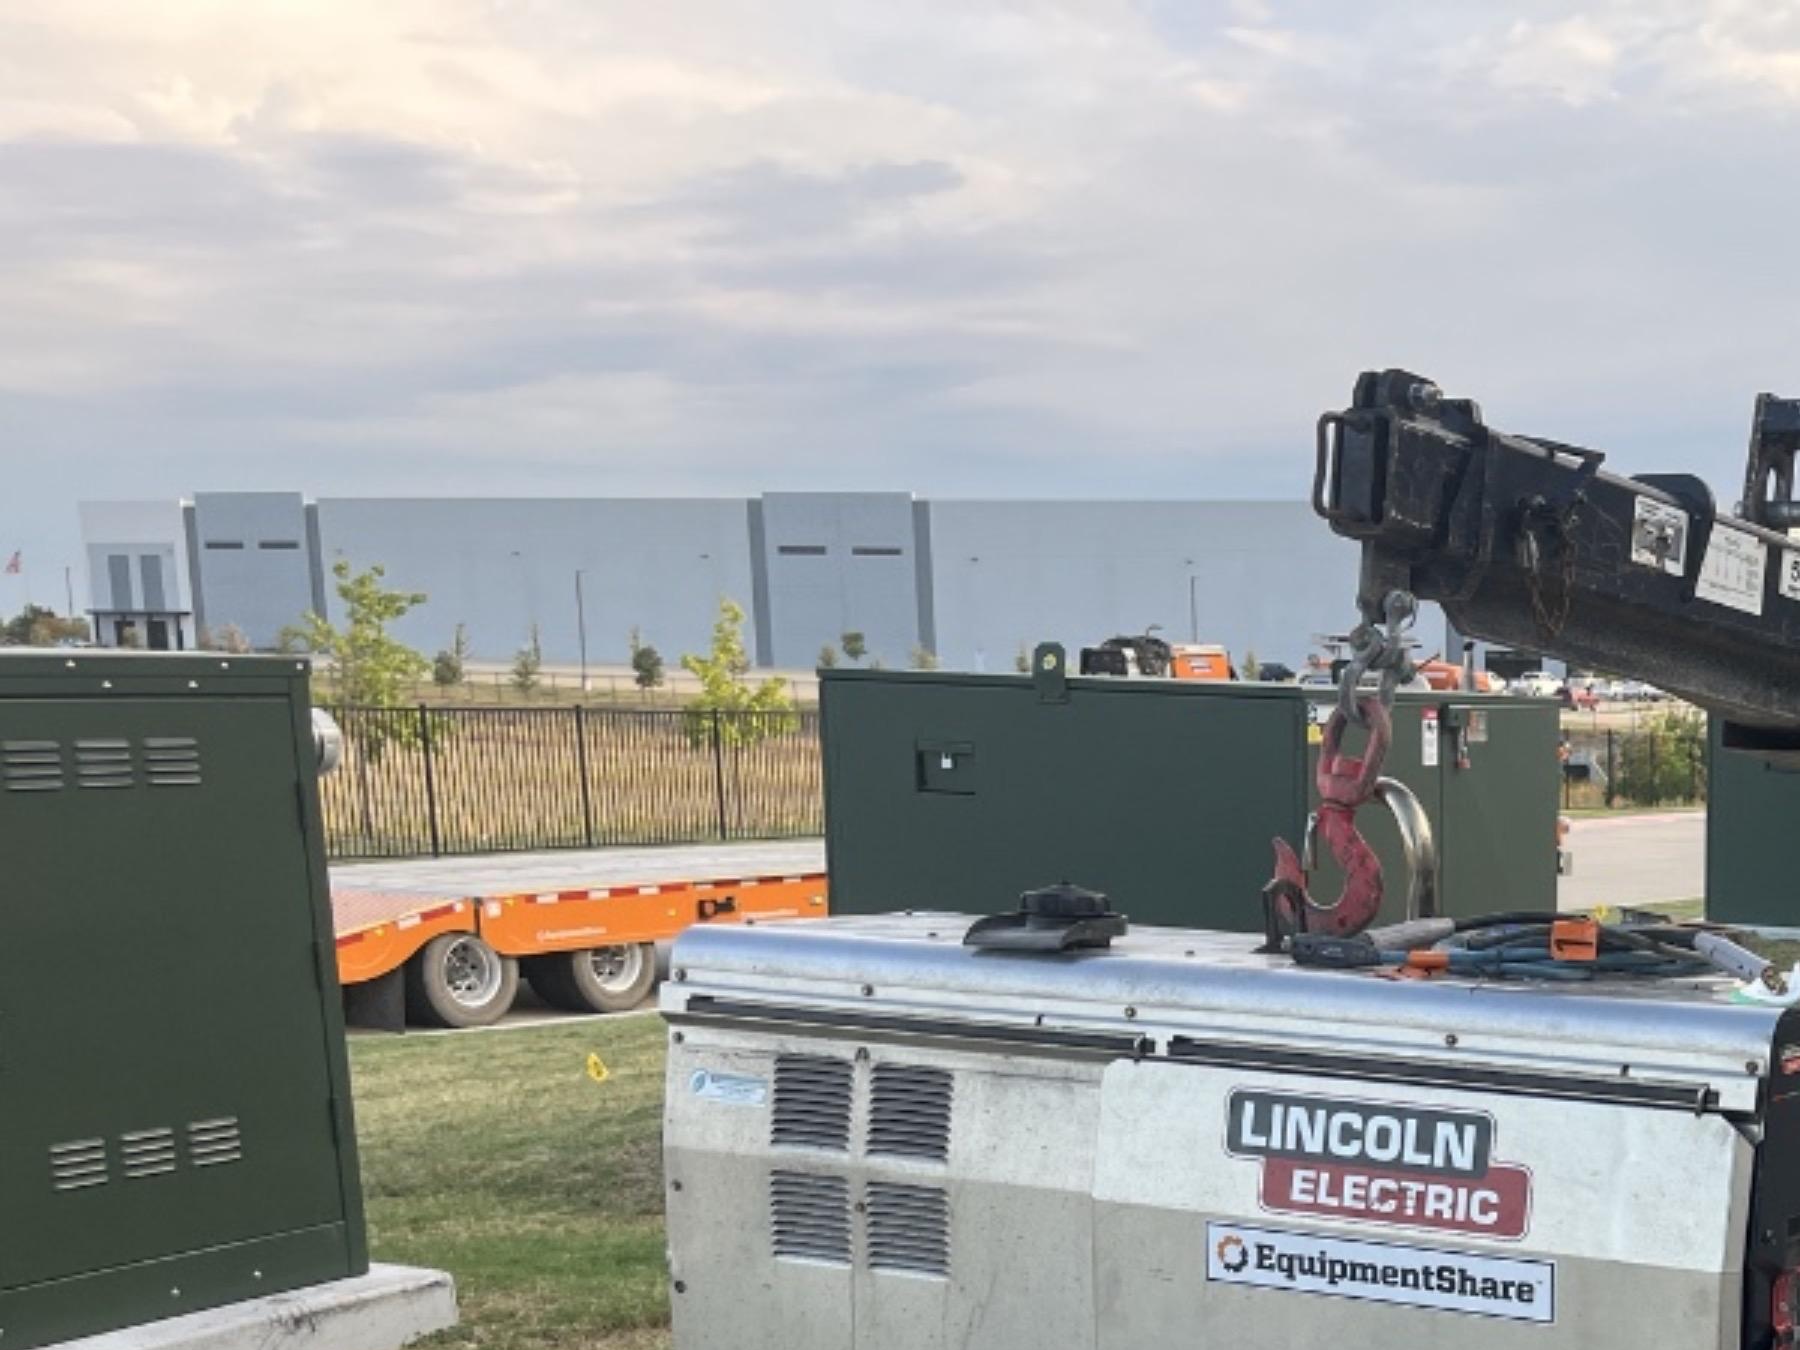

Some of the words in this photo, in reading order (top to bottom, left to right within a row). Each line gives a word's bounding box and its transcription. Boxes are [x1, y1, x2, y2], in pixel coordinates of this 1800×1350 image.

[1240, 1100, 1477, 1171] LINCOLN
[1289, 1169, 1499, 1225] ELECTRIC
[1255, 1243, 1534, 1304] EquipmentShare
